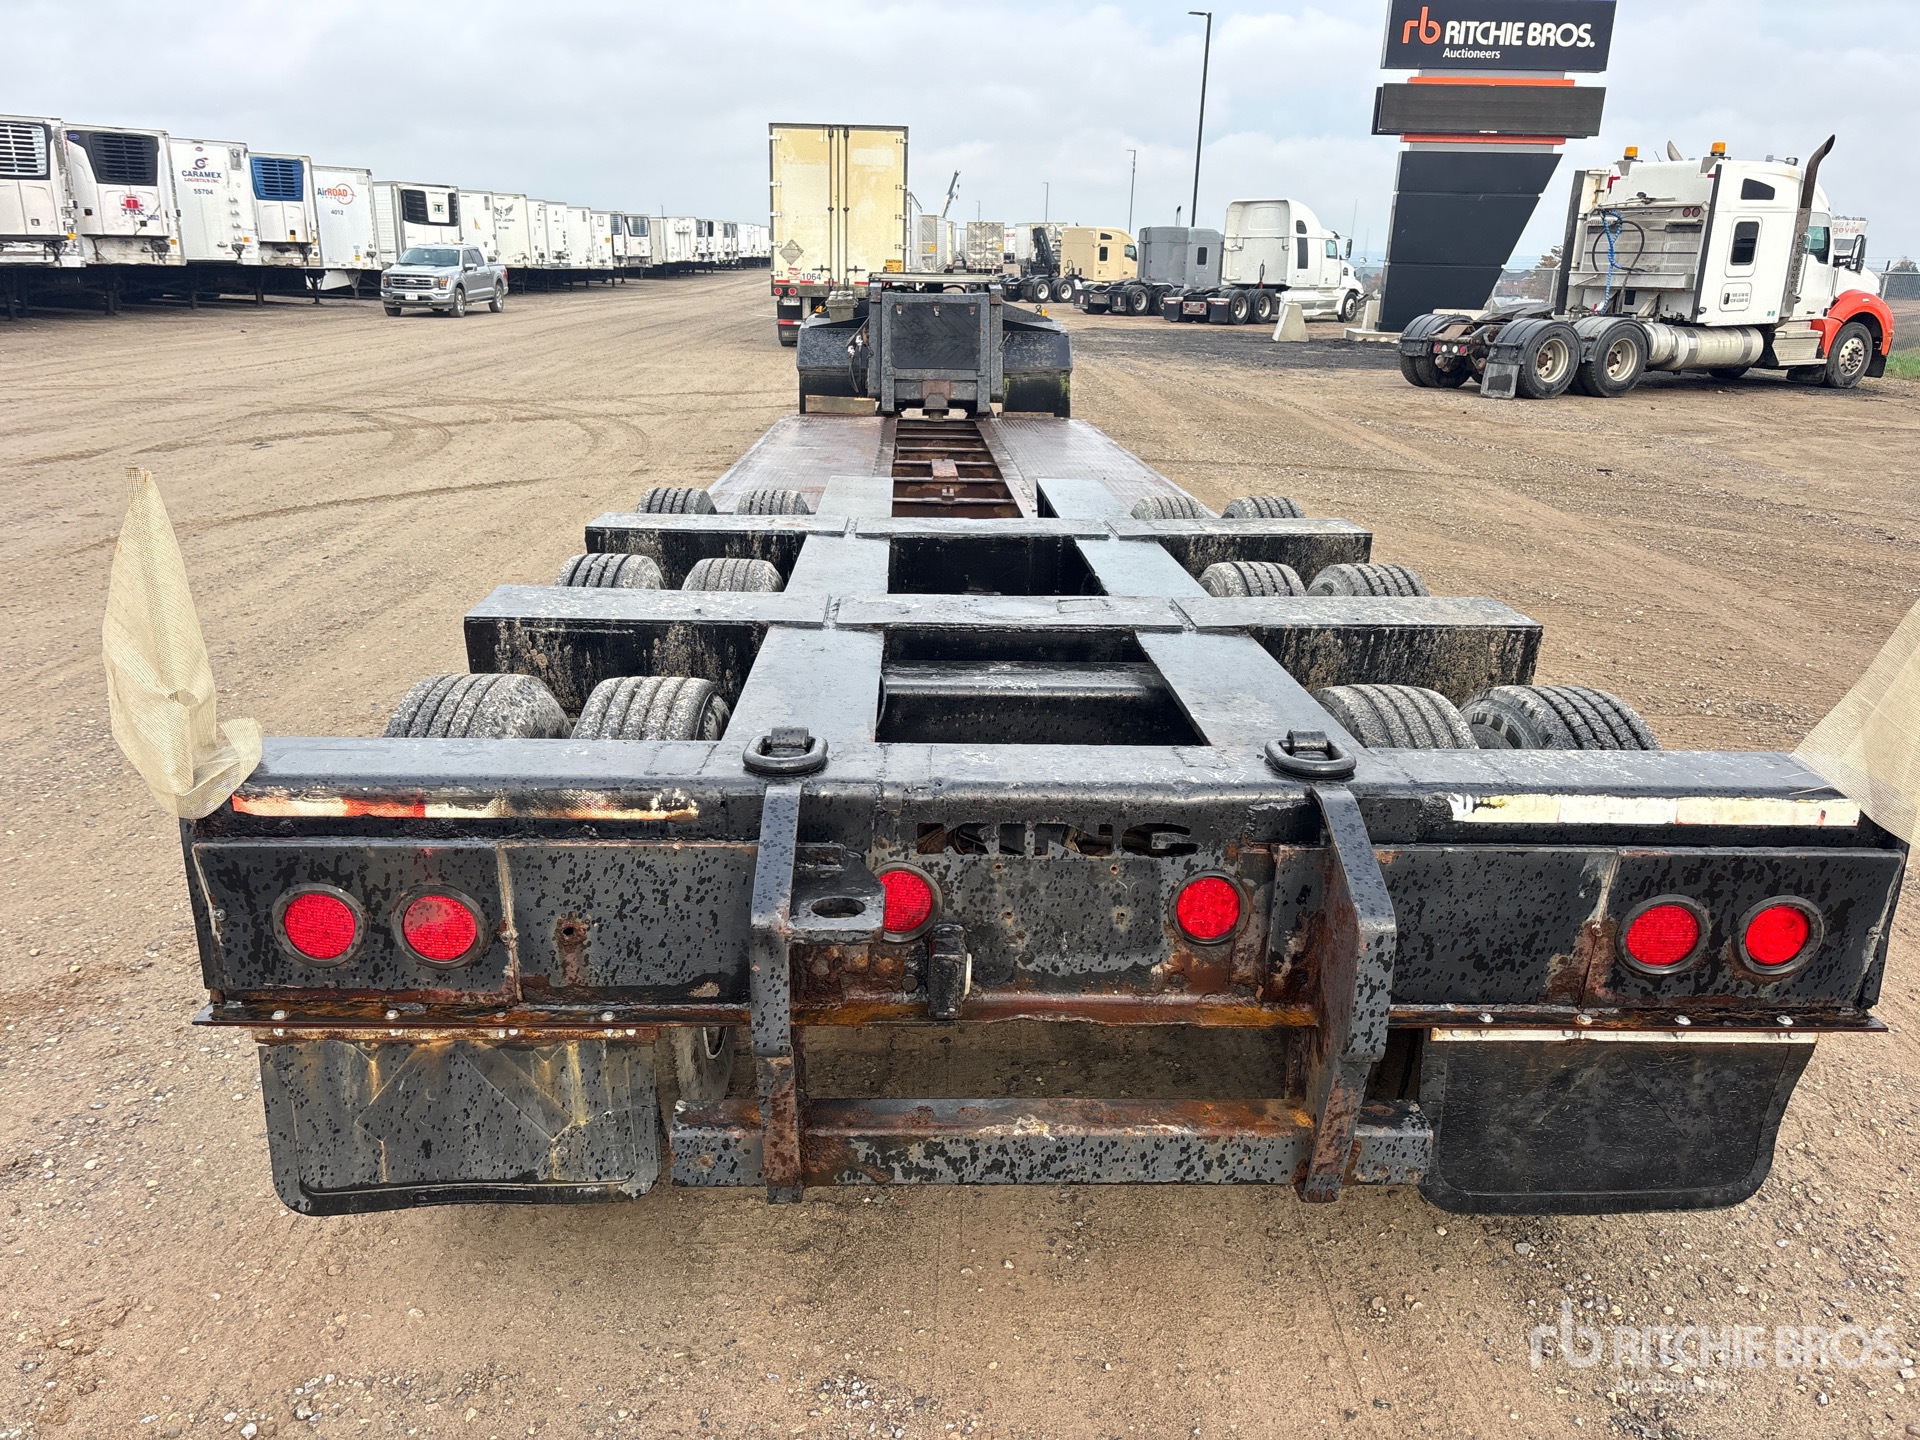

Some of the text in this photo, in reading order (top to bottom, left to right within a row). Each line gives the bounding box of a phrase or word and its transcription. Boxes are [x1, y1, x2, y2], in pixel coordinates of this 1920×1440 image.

[1402, 6, 1596, 48] rb RITCHIE BROS.
[1442, 47, 1501, 60] Auctioneers
[181, 170, 222, 179] CARAMEX
[317, 187, 348, 197] AirROAD
[1833, 226, 1860, 235] geville
[1789, 234, 1804, 295] KENWORTH
[802, 272, 822, 281] 1064
